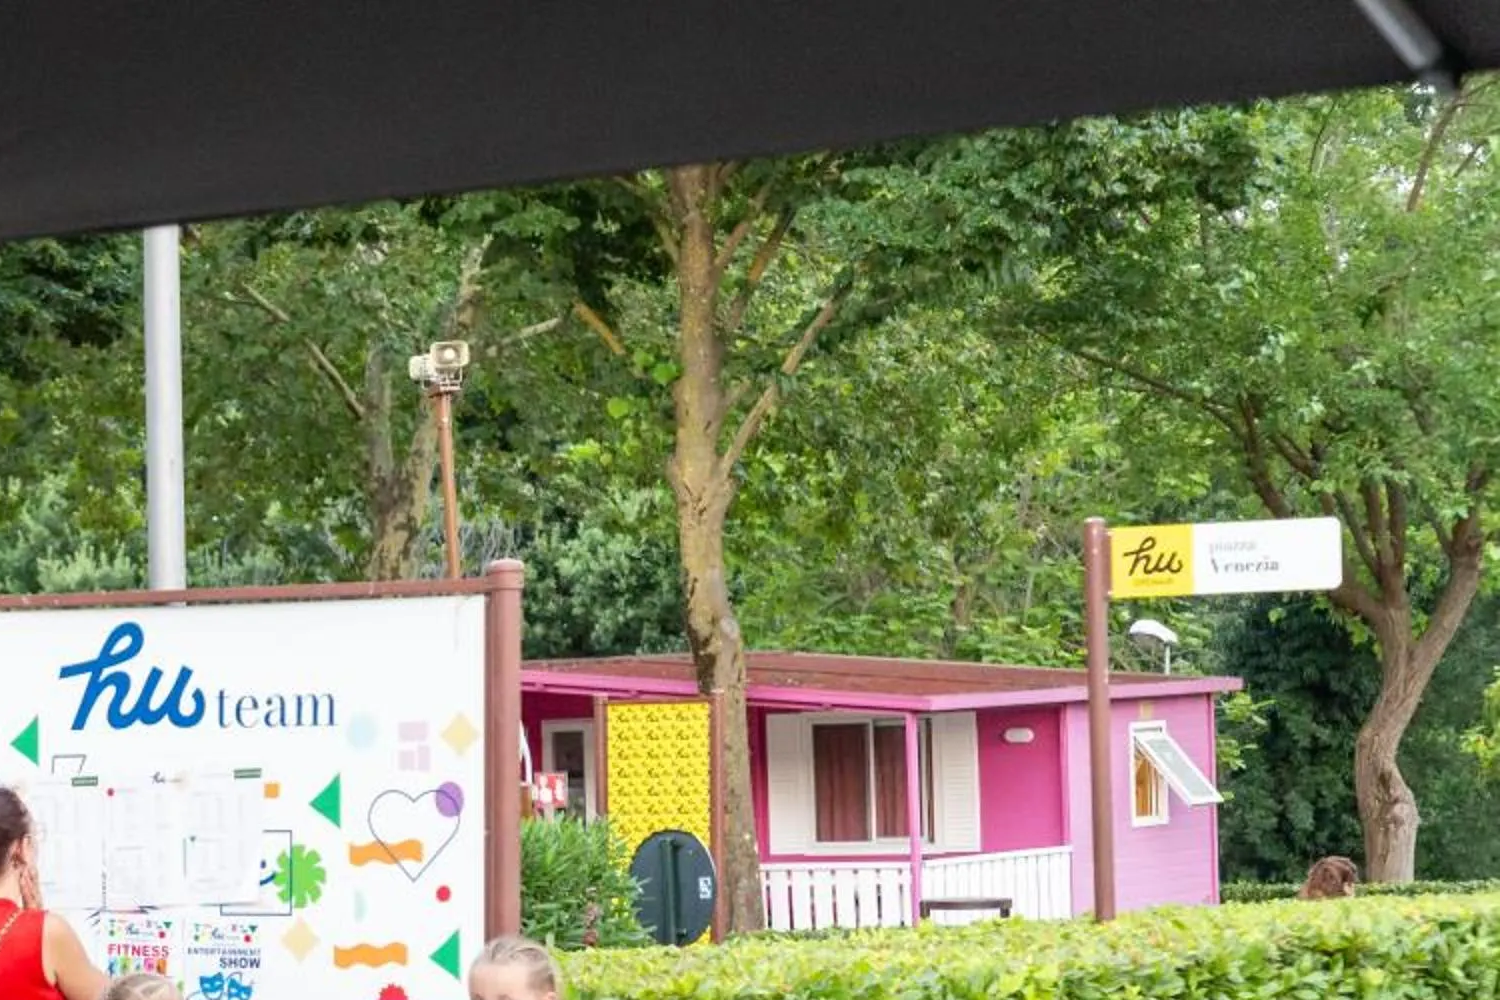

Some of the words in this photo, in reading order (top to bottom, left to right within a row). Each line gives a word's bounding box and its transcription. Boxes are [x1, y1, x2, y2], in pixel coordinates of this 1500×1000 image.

[1210, 555, 1280, 574] Venezia
[58, 621, 207, 731] hu
[216, 688, 339, 729] team
[107, 943, 170, 958] FITNESS
[187, 947, 261, 956] ENTERTAINMENT
[219, 957, 261, 969] SHOW
